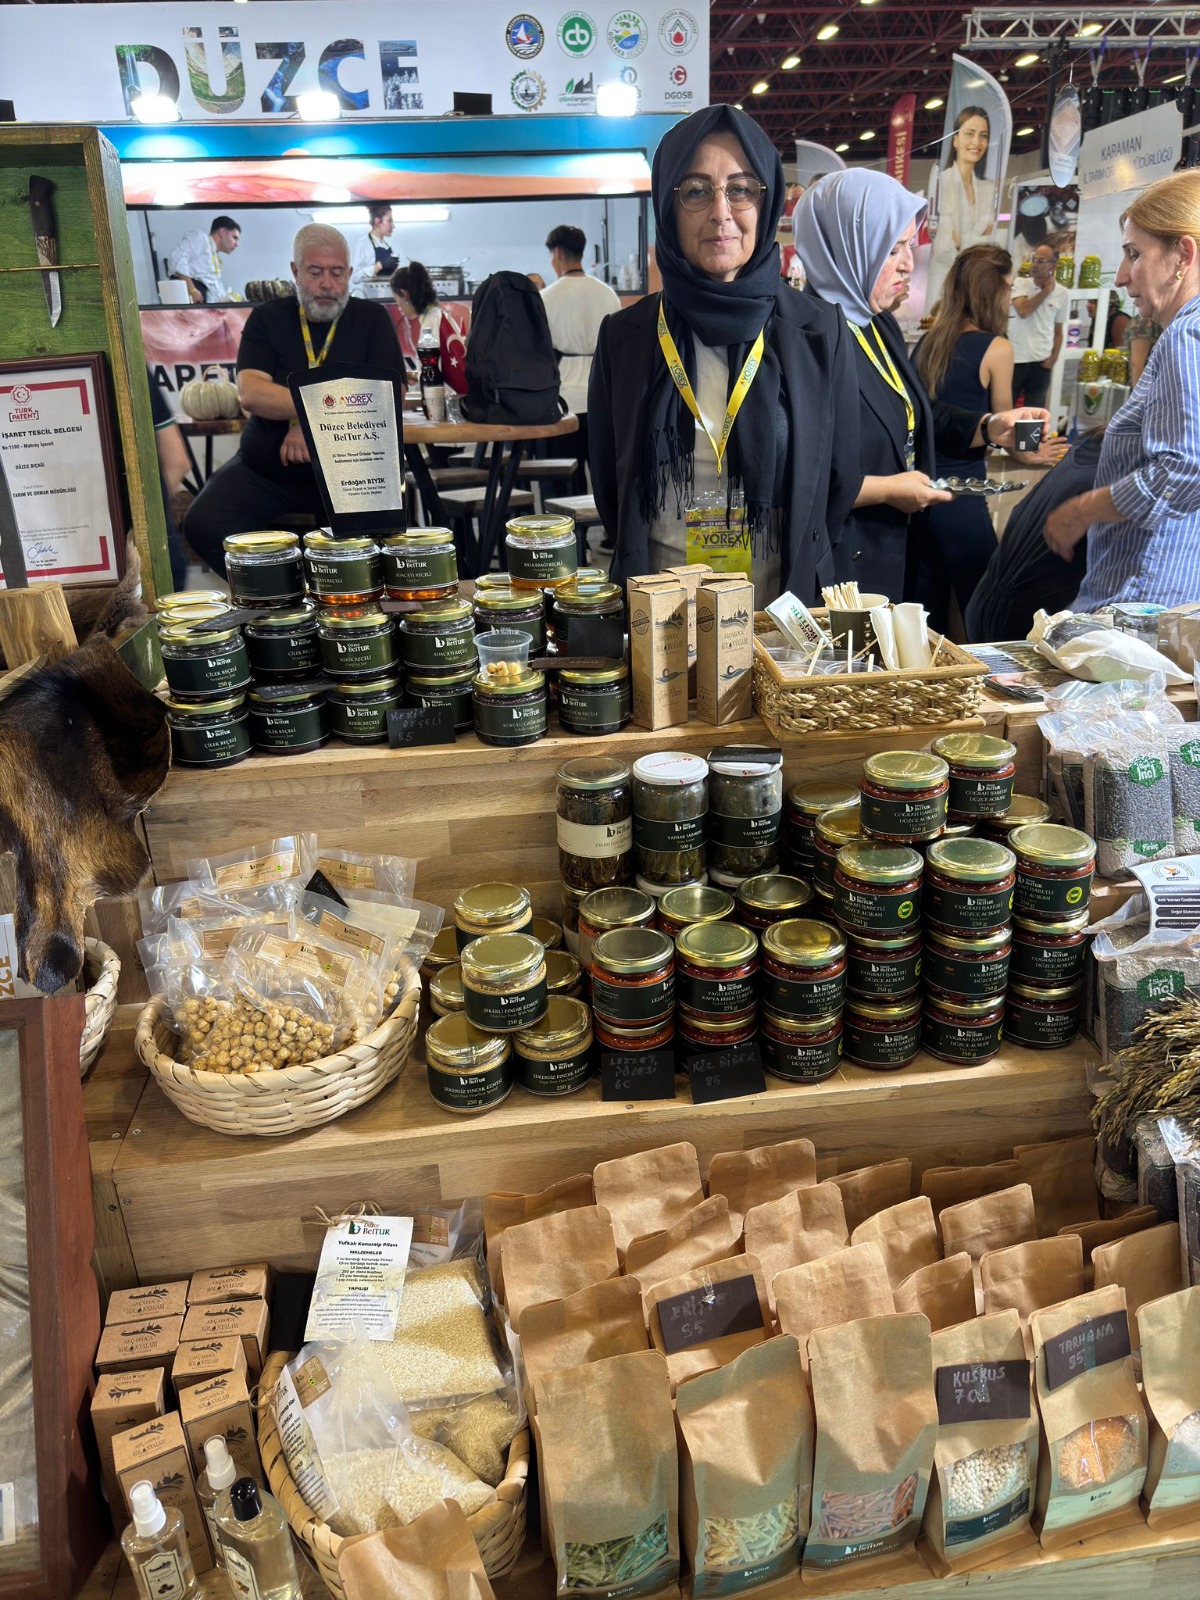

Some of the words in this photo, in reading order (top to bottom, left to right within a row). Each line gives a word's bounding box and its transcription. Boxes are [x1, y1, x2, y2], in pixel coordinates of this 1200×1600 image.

[114, 26, 424, 115] DÜZCE
[664, 92, 693, 100] DGOSB
[1101, 135, 1142, 161] KARAMAN
[319, 422, 345, 432] Düzce
[347, 420, 387, 431] Belediyesi
[2, 431, 26, 439] İŞARET
[28, 428, 52, 437] TESCİL
[54, 426, 83, 434] BELGESİ
[334, 433, 361, 442] BelTur
[363, 432, 380, 441] A.Ş.
[341, 479, 367, 487] Erdoğan
[703, 534, 742, 546] YOREX
[318, 566, 338, 574] BelTUR
[446, 639, 465, 647] BelTUR
[403, 711, 441, 728] REÇELİ
[362, 1227, 390, 1236] BelTUR
[1058, 1323, 1115, 1354] TARHANA
[953, 1366, 1006, 1388] KUSKUS
